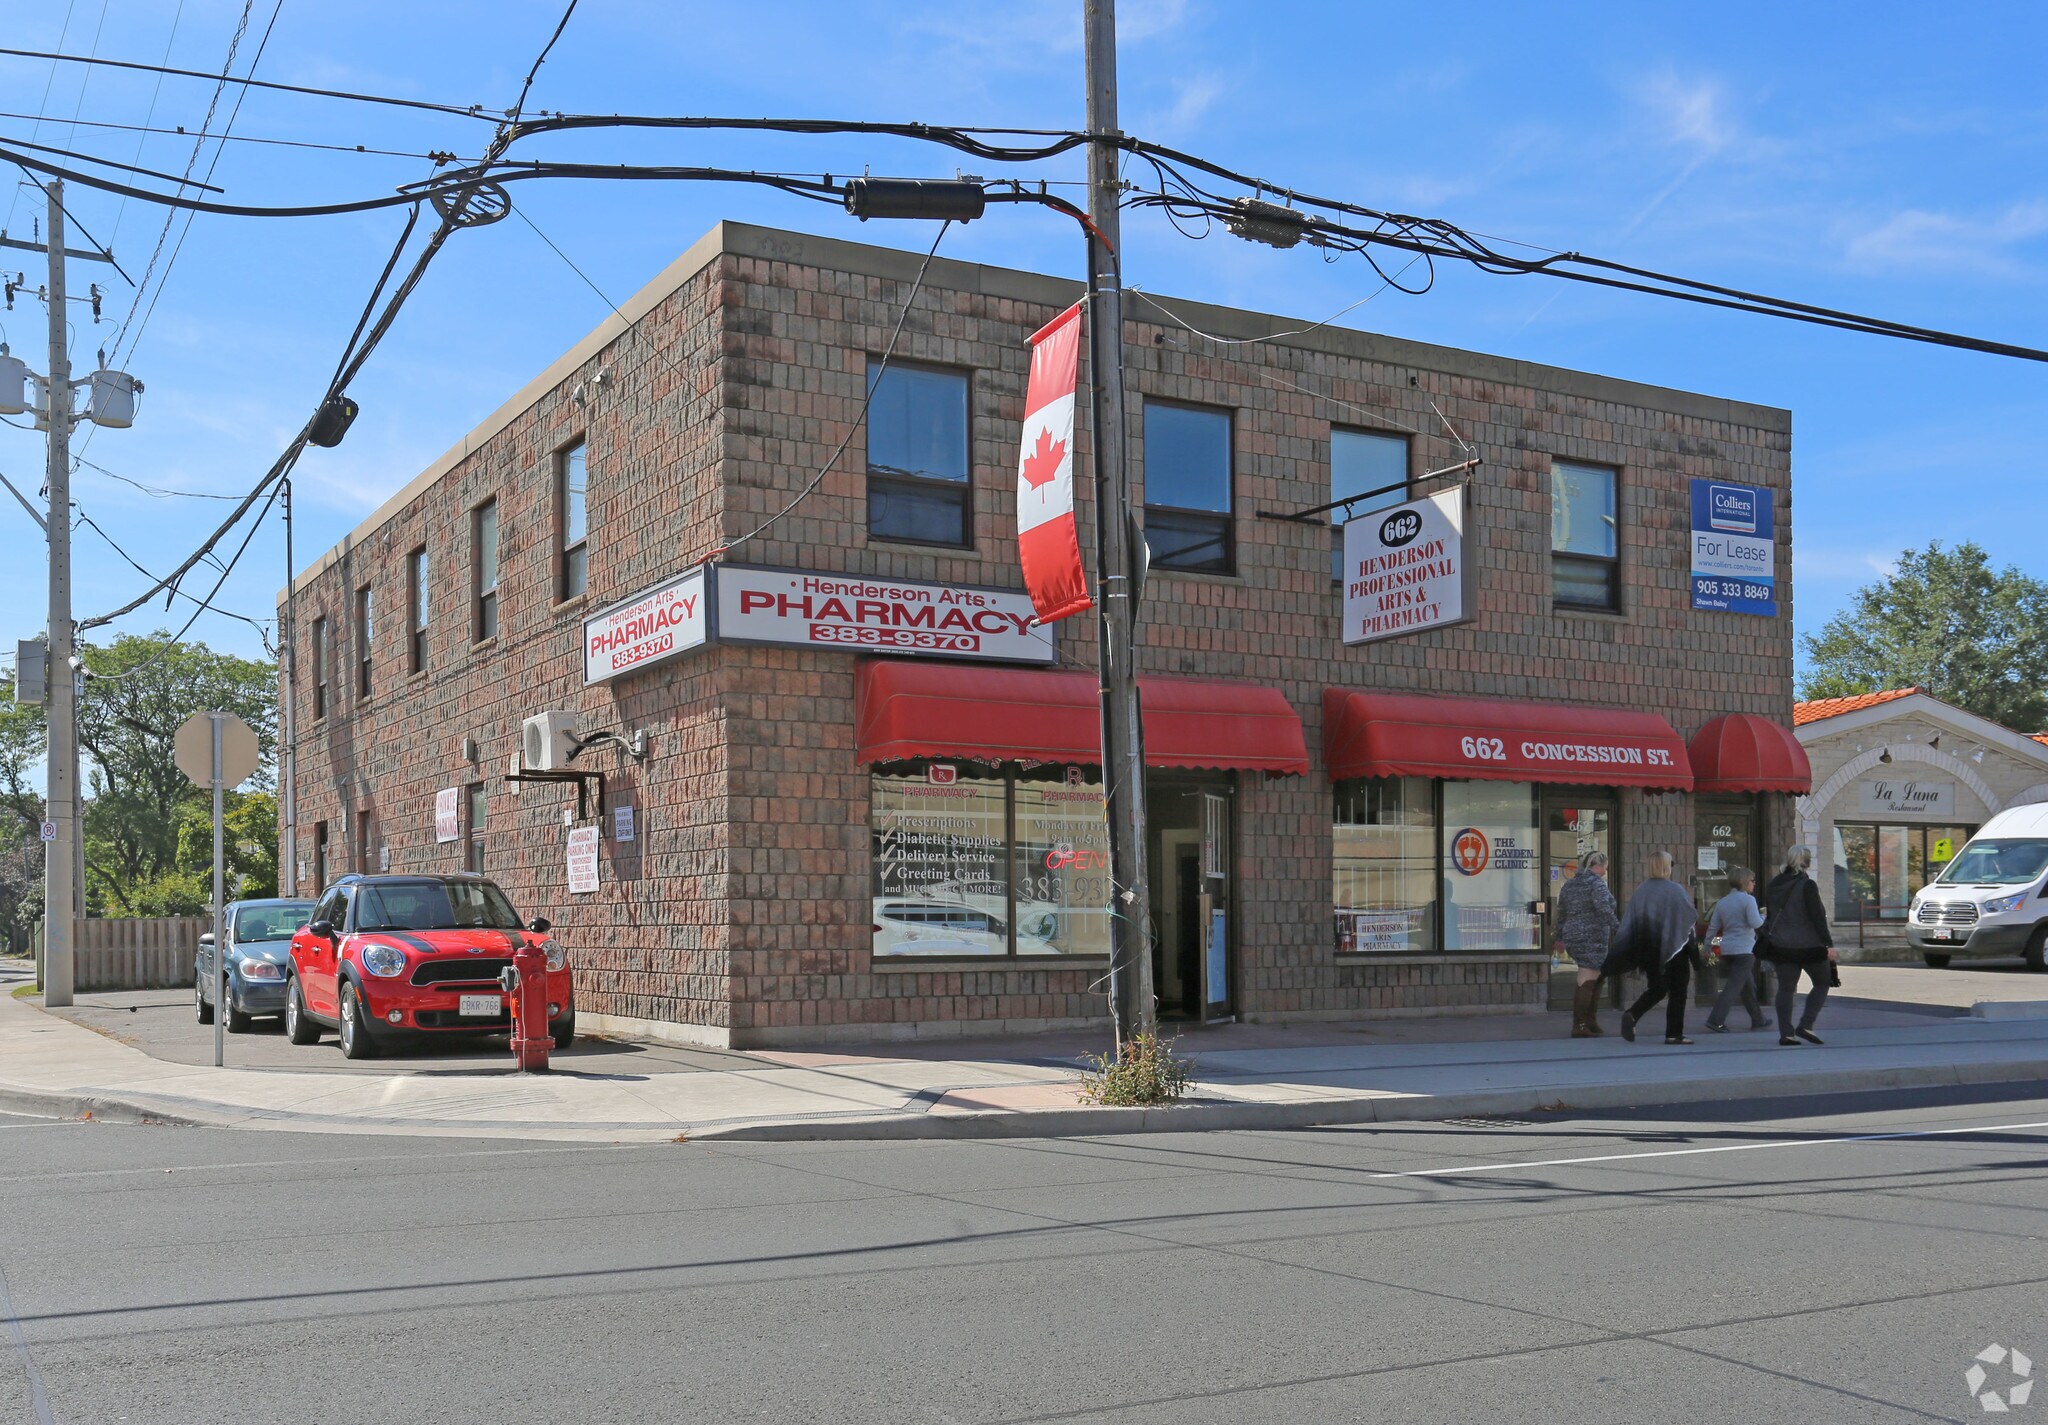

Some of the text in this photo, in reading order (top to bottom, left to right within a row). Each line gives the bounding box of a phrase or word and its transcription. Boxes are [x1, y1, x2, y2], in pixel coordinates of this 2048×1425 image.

[1716, 494, 1751, 511] Colliers
[1716, 508, 1751, 517] INTERNATIONAL
[1384, 515, 1418, 542] 662
[1697, 536, 1767, 562] For Lease
[1359, 539, 1445, 577] HENDERSON
[1350, 559, 1456, 599] PROFESSIONAL
[803, 577, 985, 607] Henderson Arts
[1697, 580, 1769, 600] 905 333 8849
[1376, 586, 1426, 613] ARTS &
[608, 589, 674, 628] Henderson Arts
[741, 590, 1036, 636] PHARMACY
[591, 593, 698, 658] PHARMACY
[1362, 602, 1441, 635] PHARMACY
[815, 625, 975, 650] 383-9370
[614, 634, 671, 668] 383-9370
[1461, 736, 1674, 766] 662 CONCESSION ST.
[903, 786, 978, 799] PHARMACY
[1043, 791, 1105, 803] PHARMAC
[1873, 780, 1939, 802] La Luna
[897, 815, 977, 830] Prescriptions
[1034, 820, 1074, 833] Monday
[571, 830, 593, 843] PHARMACY
[1712, 825, 1731, 837] 662
[896, 832, 1001, 848] Diabetic Supplies
[1494, 838, 1515, 847] THE
[896, 849, 995, 864] Delivery Service
[1045, 850, 1108, 870] OPEN
[1494, 849, 1534, 859] CAYDEN
[1494, 860, 1528, 869] CLINIC
[896, 866, 991, 882] Greeting Cards
[884, 884, 901, 893] and
[1361, 923, 1403, 933] HENDERSON
[1374, 933, 1392, 941] ARTS
[1362, 941, 1401, 951] PHARMACY
